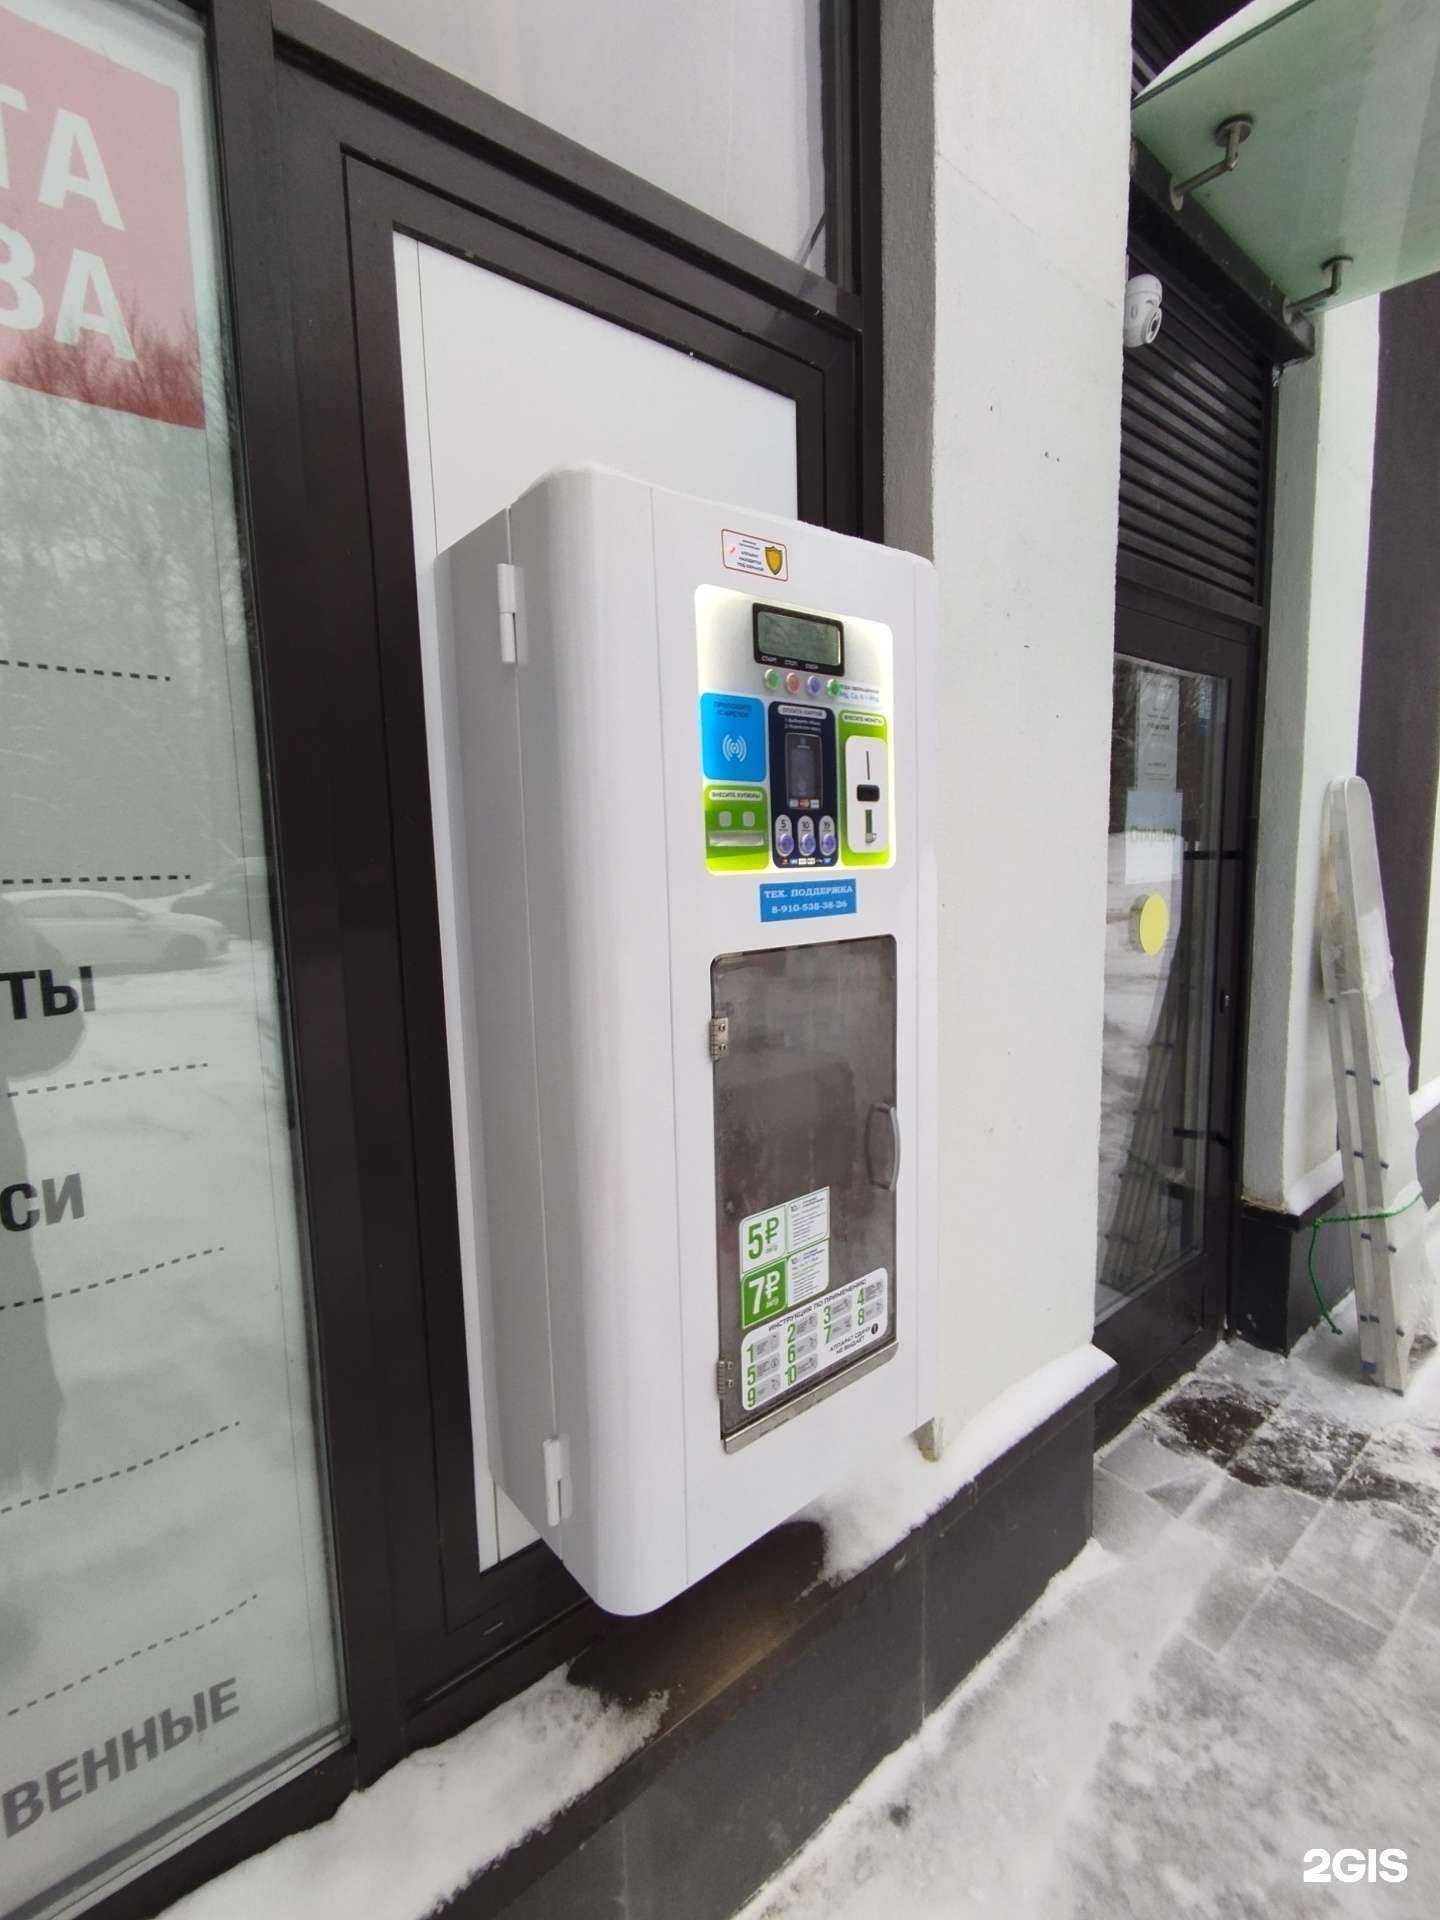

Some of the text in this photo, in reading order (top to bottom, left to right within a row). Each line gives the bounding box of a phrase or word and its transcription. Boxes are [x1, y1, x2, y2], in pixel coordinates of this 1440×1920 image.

[763, 885, 854, 899] ТЕХ. ПОДДЕРЖКА
[0, 965, 96, 1020] ТЫ
[0, 1172, 85, 1232] СИ
[857, 1287, 865, 1306] 4
[823, 1305, 832, 1325] 3
[857, 1308, 865, 1326] 8
[787, 1323, 796, 1344] 2
[823, 1324, 833, 1345] 7
[746, 1343, 754, 1363] 1
[787, 1344, 796, 1364] 6
[746, 1365, 756, 1386] 5
[785, 1364, 797, 1387] 10
[747, 1387, 756, 1408] 9
[1, 1676, 241, 1839] ВЕННЫЕ
